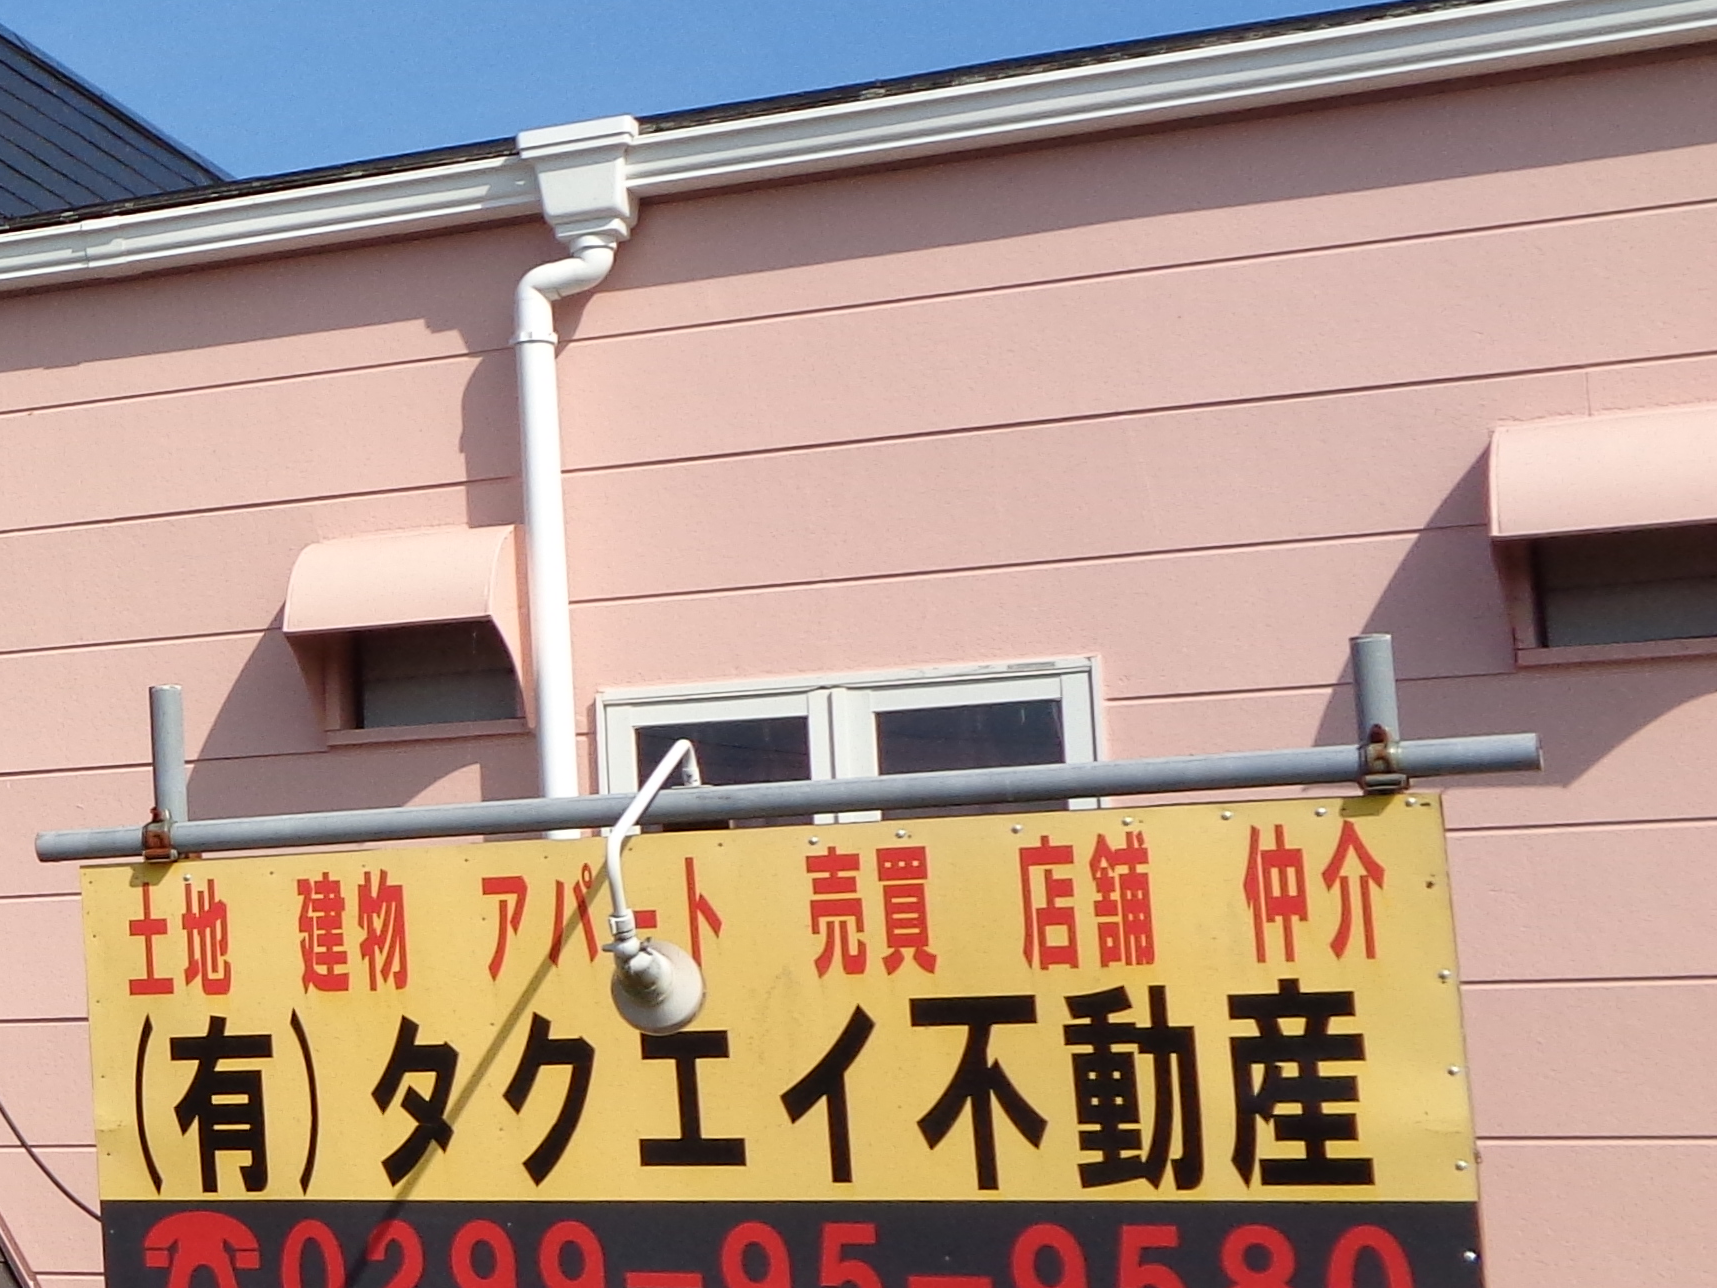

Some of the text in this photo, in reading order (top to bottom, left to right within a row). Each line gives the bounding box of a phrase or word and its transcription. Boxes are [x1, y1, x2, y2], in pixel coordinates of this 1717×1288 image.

[128, 878, 232, 997] 土地
[297, 870, 408, 993] 建物
[807, 845, 938, 977] 売買
[1019, 833, 1157, 970] 店舗
[1243, 820, 1385, 962] 仲介
[135, 978, 1375, 1194] (有)タクエイ不動産
